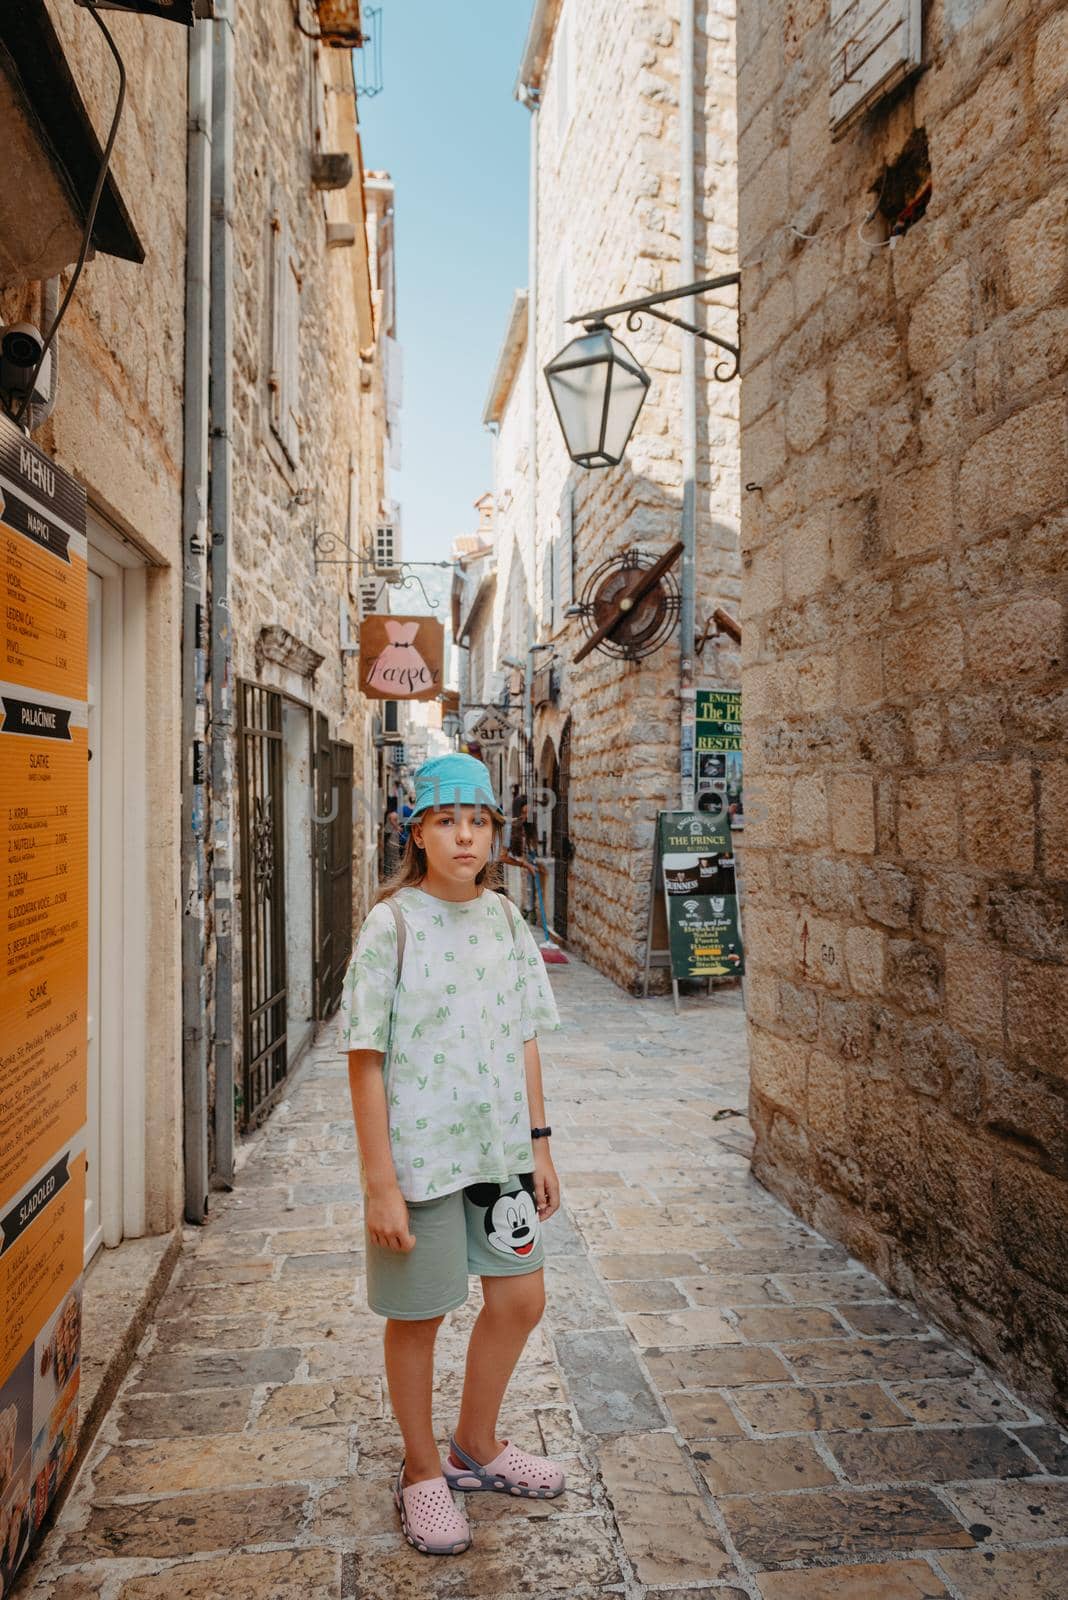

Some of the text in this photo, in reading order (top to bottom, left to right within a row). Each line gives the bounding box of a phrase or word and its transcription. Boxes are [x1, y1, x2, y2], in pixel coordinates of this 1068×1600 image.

[20, 446, 55, 498] MENU
[27, 512, 49, 541] NAPICI
[7, 639, 19, 655] PIVO
[21, 707, 56, 729] PALAČINKE
[701, 702, 723, 719] The
[480, 728, 505, 740] art
[29, 753, 50, 769] SLATKE
[13, 835, 36, 851] NUTELLA
[668, 835, 727, 846] THE PRINCE
[19, 1176, 56, 1226] SLADOLED
